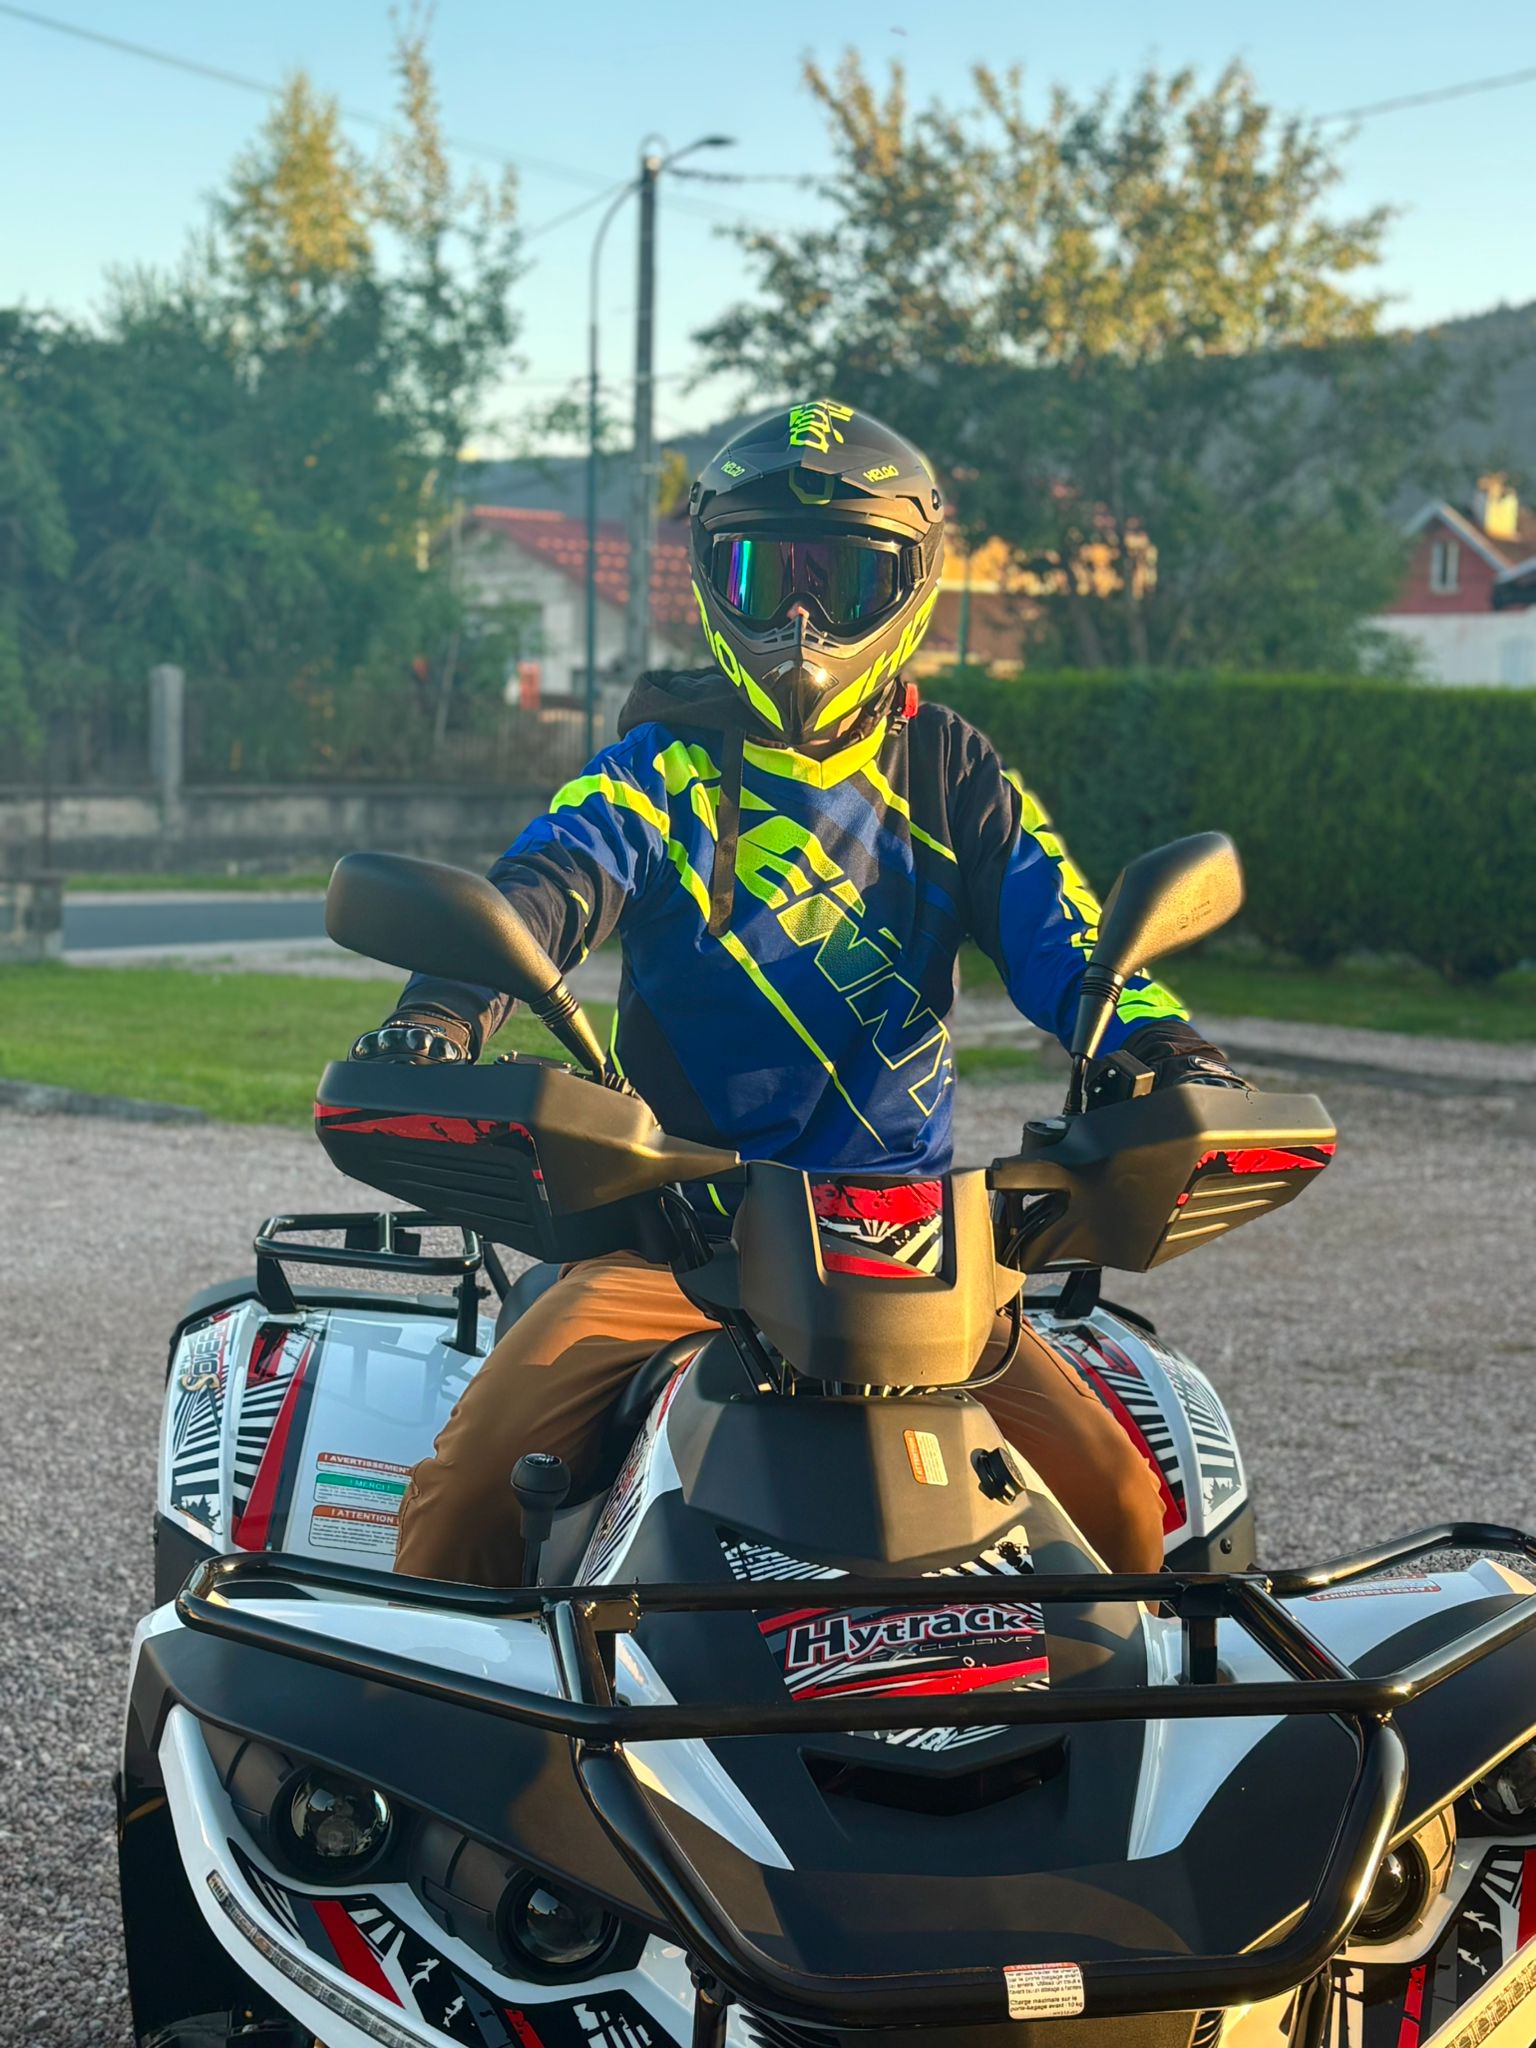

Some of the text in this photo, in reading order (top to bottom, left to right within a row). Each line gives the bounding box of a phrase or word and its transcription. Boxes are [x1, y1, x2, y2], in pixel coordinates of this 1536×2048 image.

[354, 1480, 386, 1490] MERCI
[337, 1508, 394, 1523] ATTENTION
[788, 1608, 1028, 1669] Hytrack
